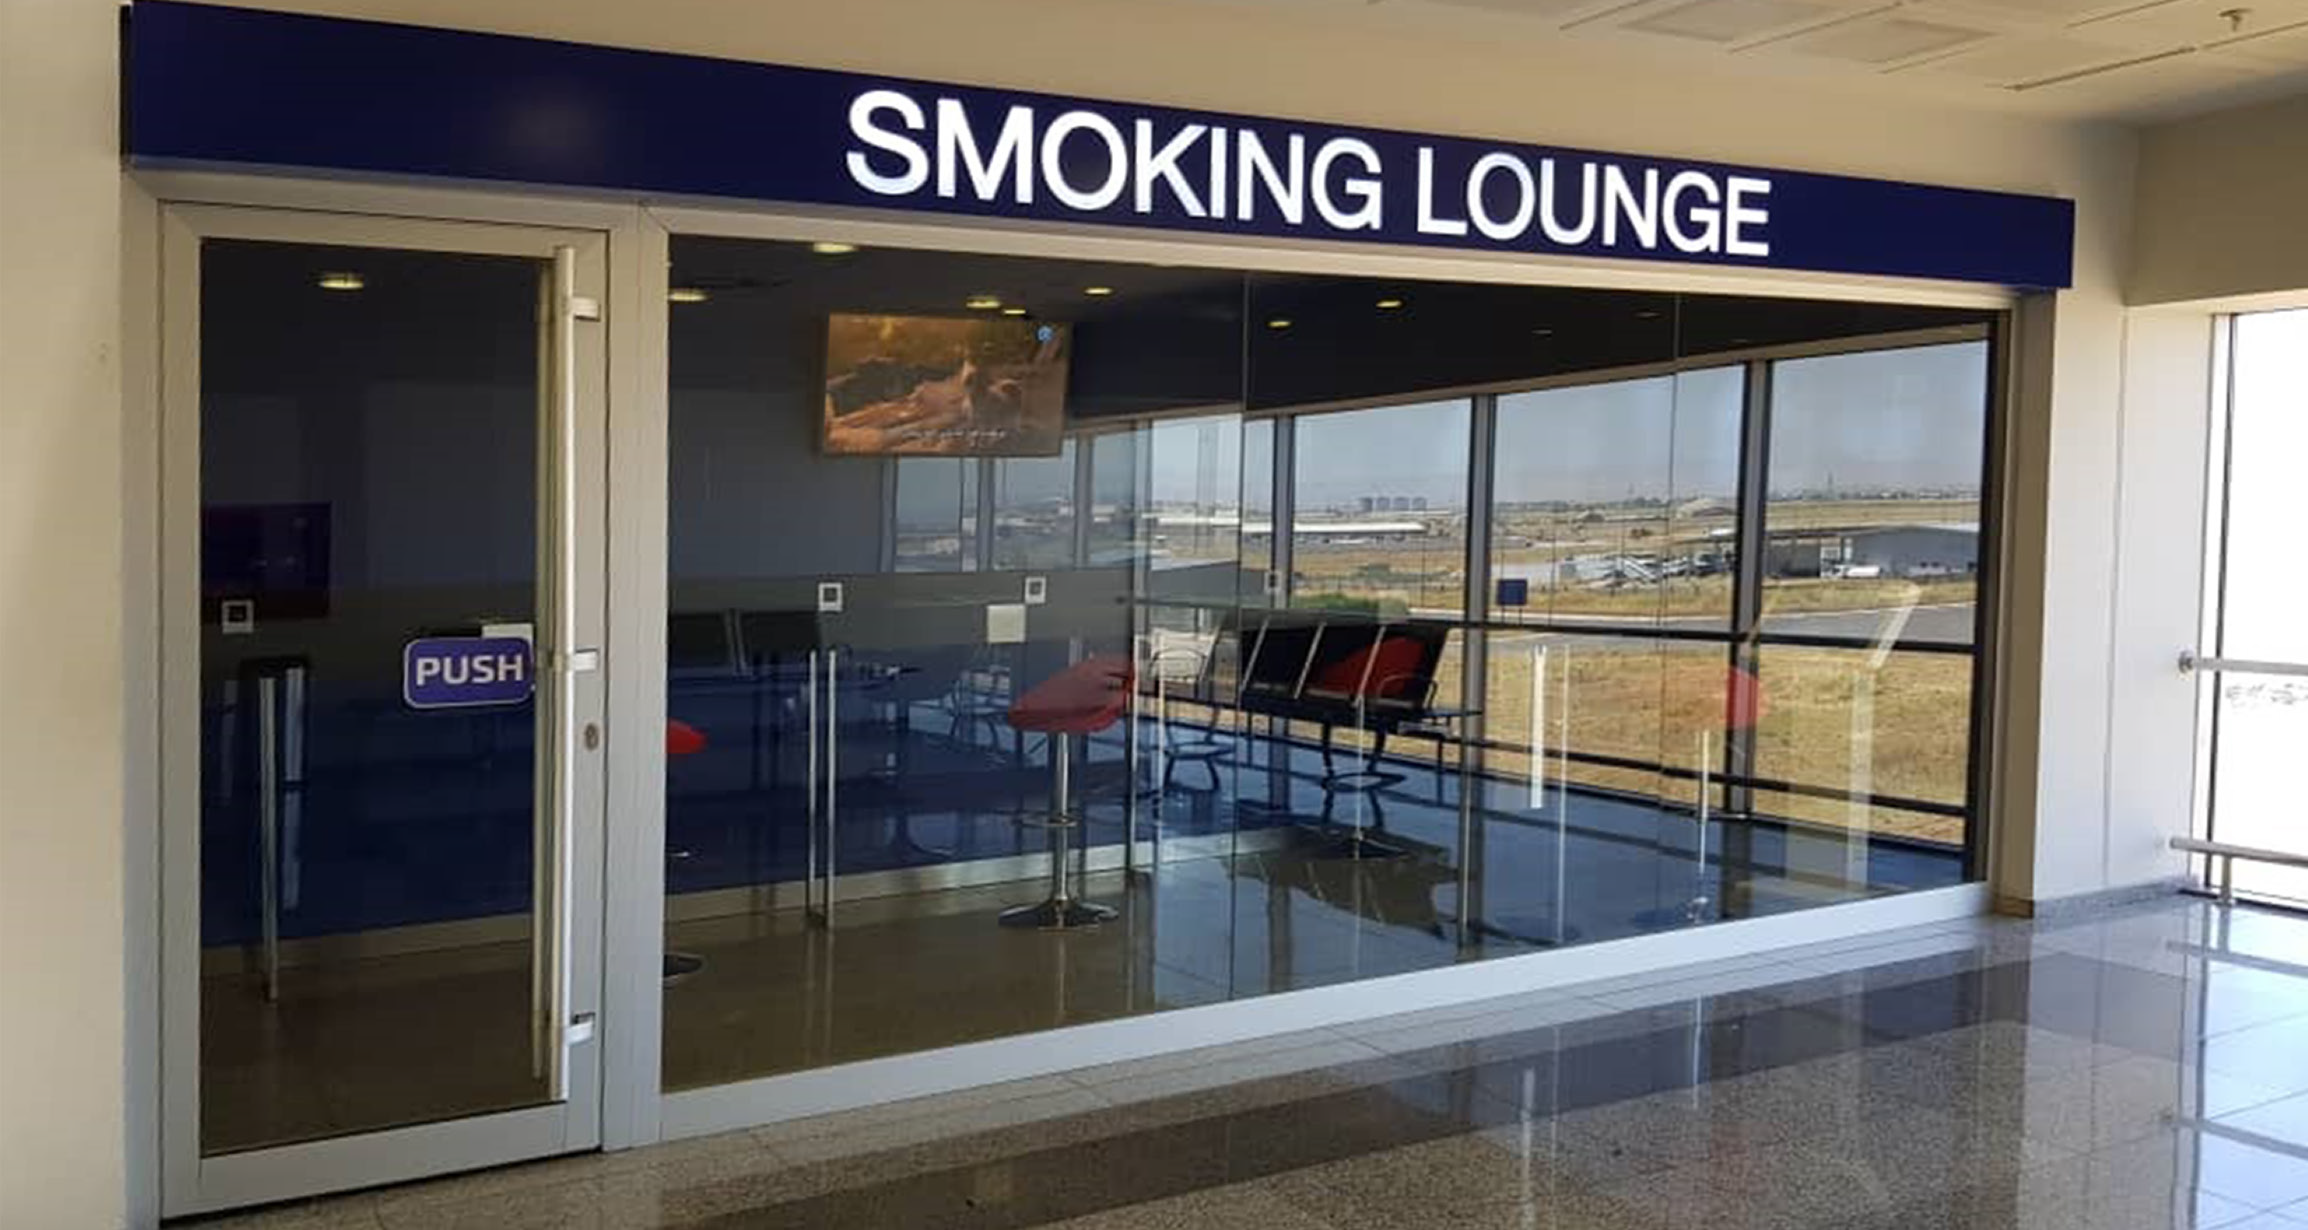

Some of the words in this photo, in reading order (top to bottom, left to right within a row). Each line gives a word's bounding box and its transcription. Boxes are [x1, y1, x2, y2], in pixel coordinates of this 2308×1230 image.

[846, 90, 1382, 230] SMOKING
[1416, 147, 1771, 257] LOUNGE
[415, 654, 524, 686] PUSH
